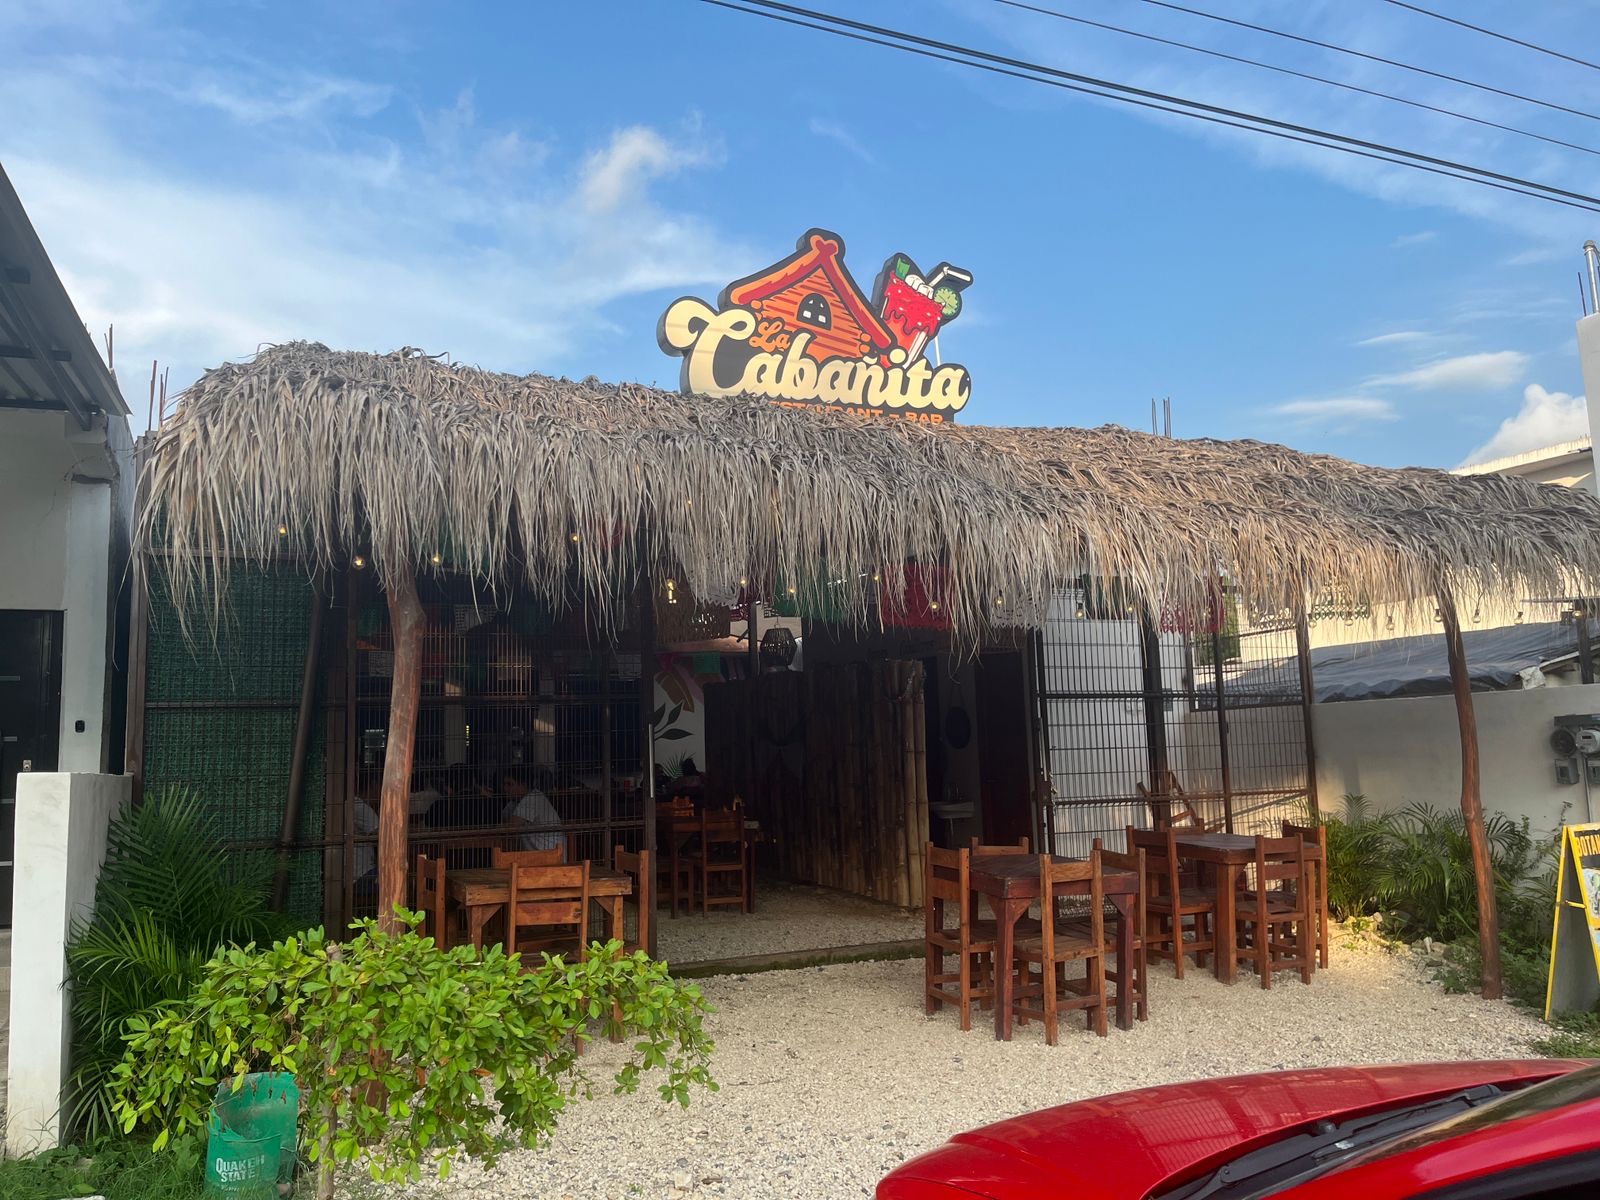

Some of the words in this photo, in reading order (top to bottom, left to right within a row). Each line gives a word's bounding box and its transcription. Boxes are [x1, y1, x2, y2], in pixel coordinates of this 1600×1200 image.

[748, 321, 790, 352] La
[665, 299, 969, 410] Cabañita
[221, 1170, 256, 1183] STATE
